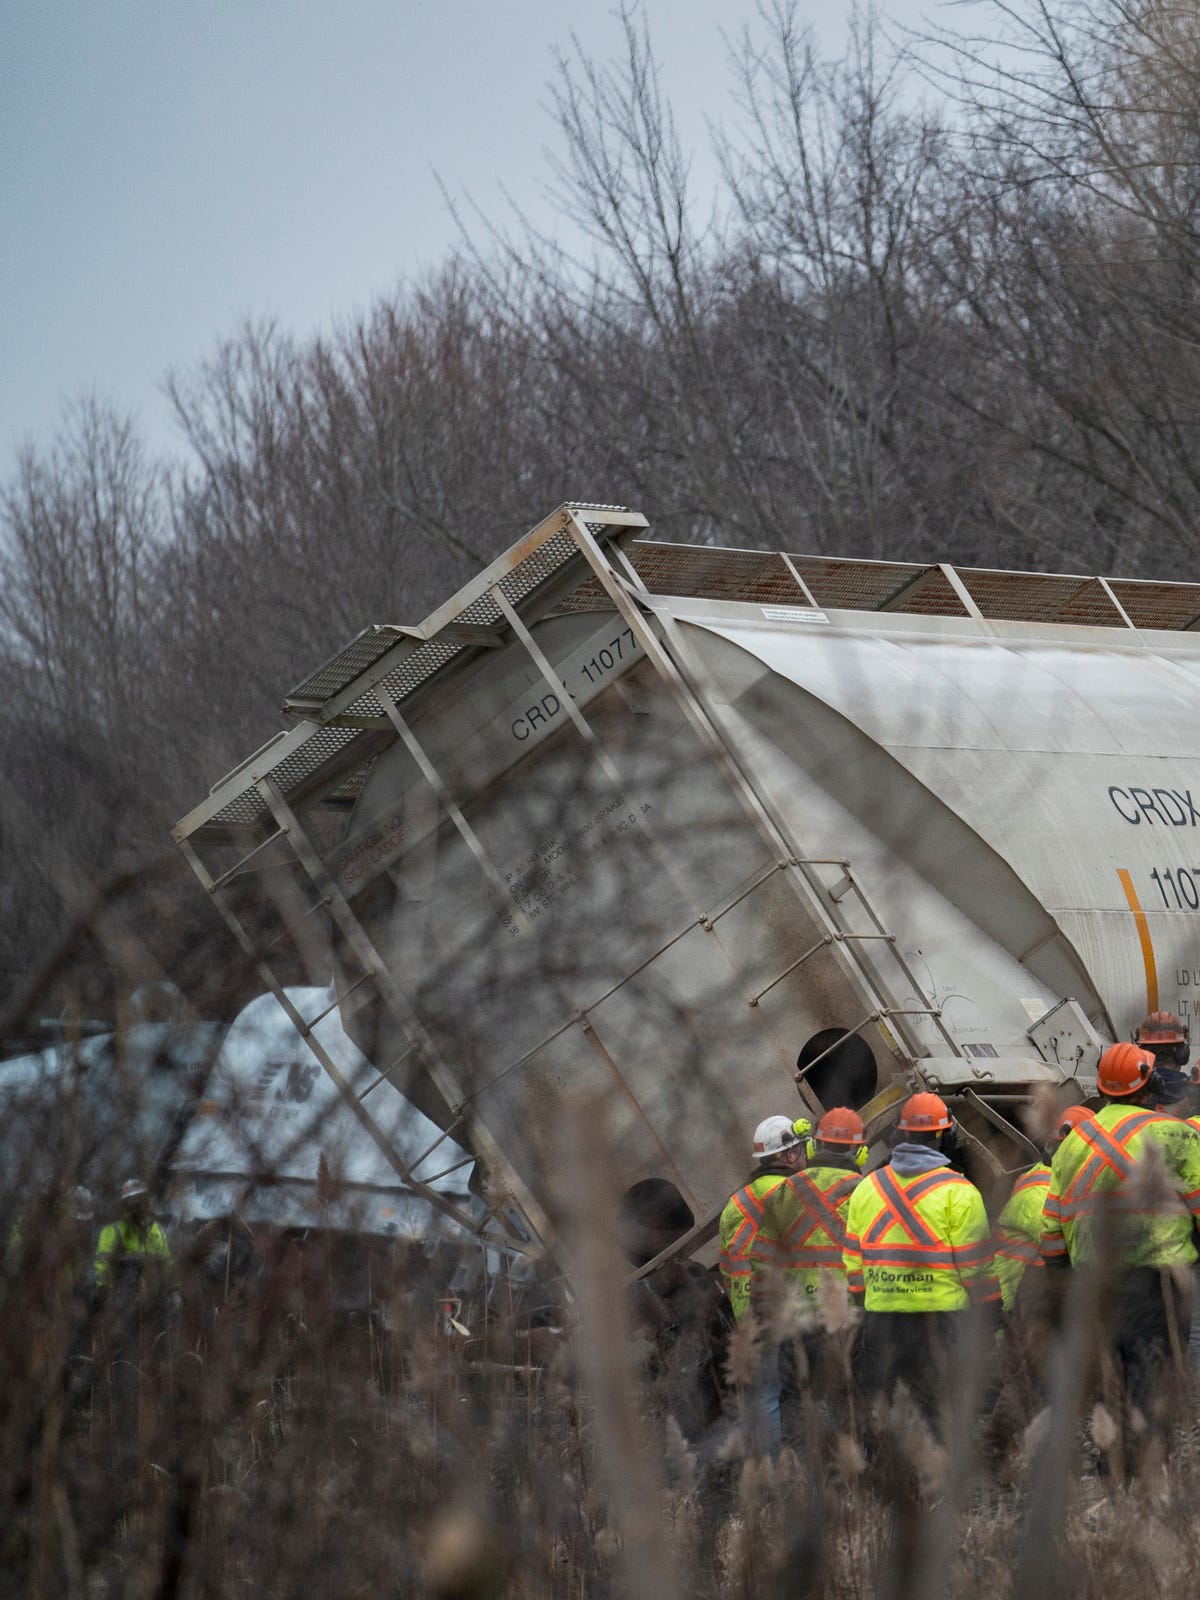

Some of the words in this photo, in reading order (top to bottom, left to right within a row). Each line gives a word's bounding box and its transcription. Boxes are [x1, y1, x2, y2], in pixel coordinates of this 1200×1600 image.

[581, 627, 637, 682] 11077
[1176, 970, 1190, 986] LD
[881, 1271, 935, 1283] Corman
